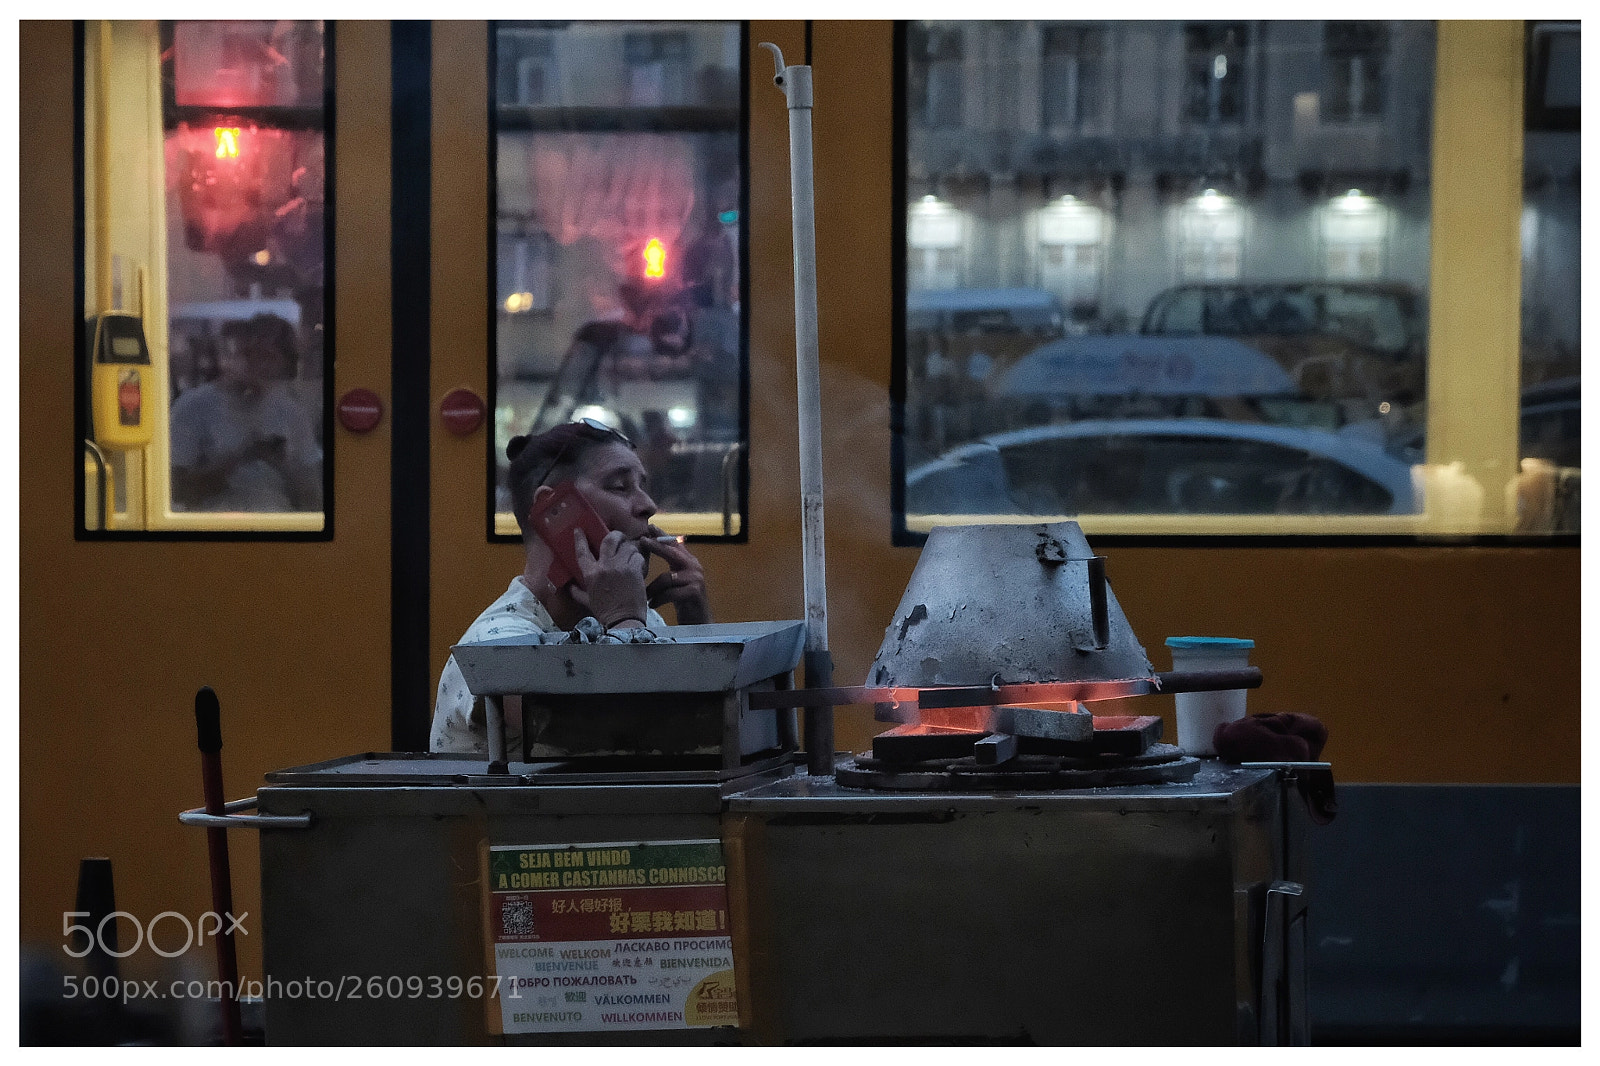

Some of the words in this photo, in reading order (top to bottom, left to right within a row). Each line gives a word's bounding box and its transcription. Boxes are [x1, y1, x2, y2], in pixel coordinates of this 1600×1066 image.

[519, 852, 551, 869] SEJA
[553, 851, 584, 868] BEM
[586, 850, 631, 867] VINDO
[499, 873, 508, 889] A
[510, 872, 560, 888] COMER
[562, 869, 647, 887] CASTANHAS
[649, 865, 726, 884] CONNOSCO
[498, 947, 554, 959] WELCOME
[614, 941, 670, 953] ЛАСКАВО
[559, 949, 612, 960] WELKOM
[534, 960, 599, 972] BIENVENUE
[659, 957, 731, 969] BIENVENIDA
[509, 976, 550, 990] ДОБРО
[553, 975, 638, 987] ПОЖАЛОВАТЬ
[594, 993, 670, 1006] VÄLKOMMEN
[512, 1011, 583, 1024] BENVENUTO
[601, 1011, 683, 1024] WILLKOMMEN
